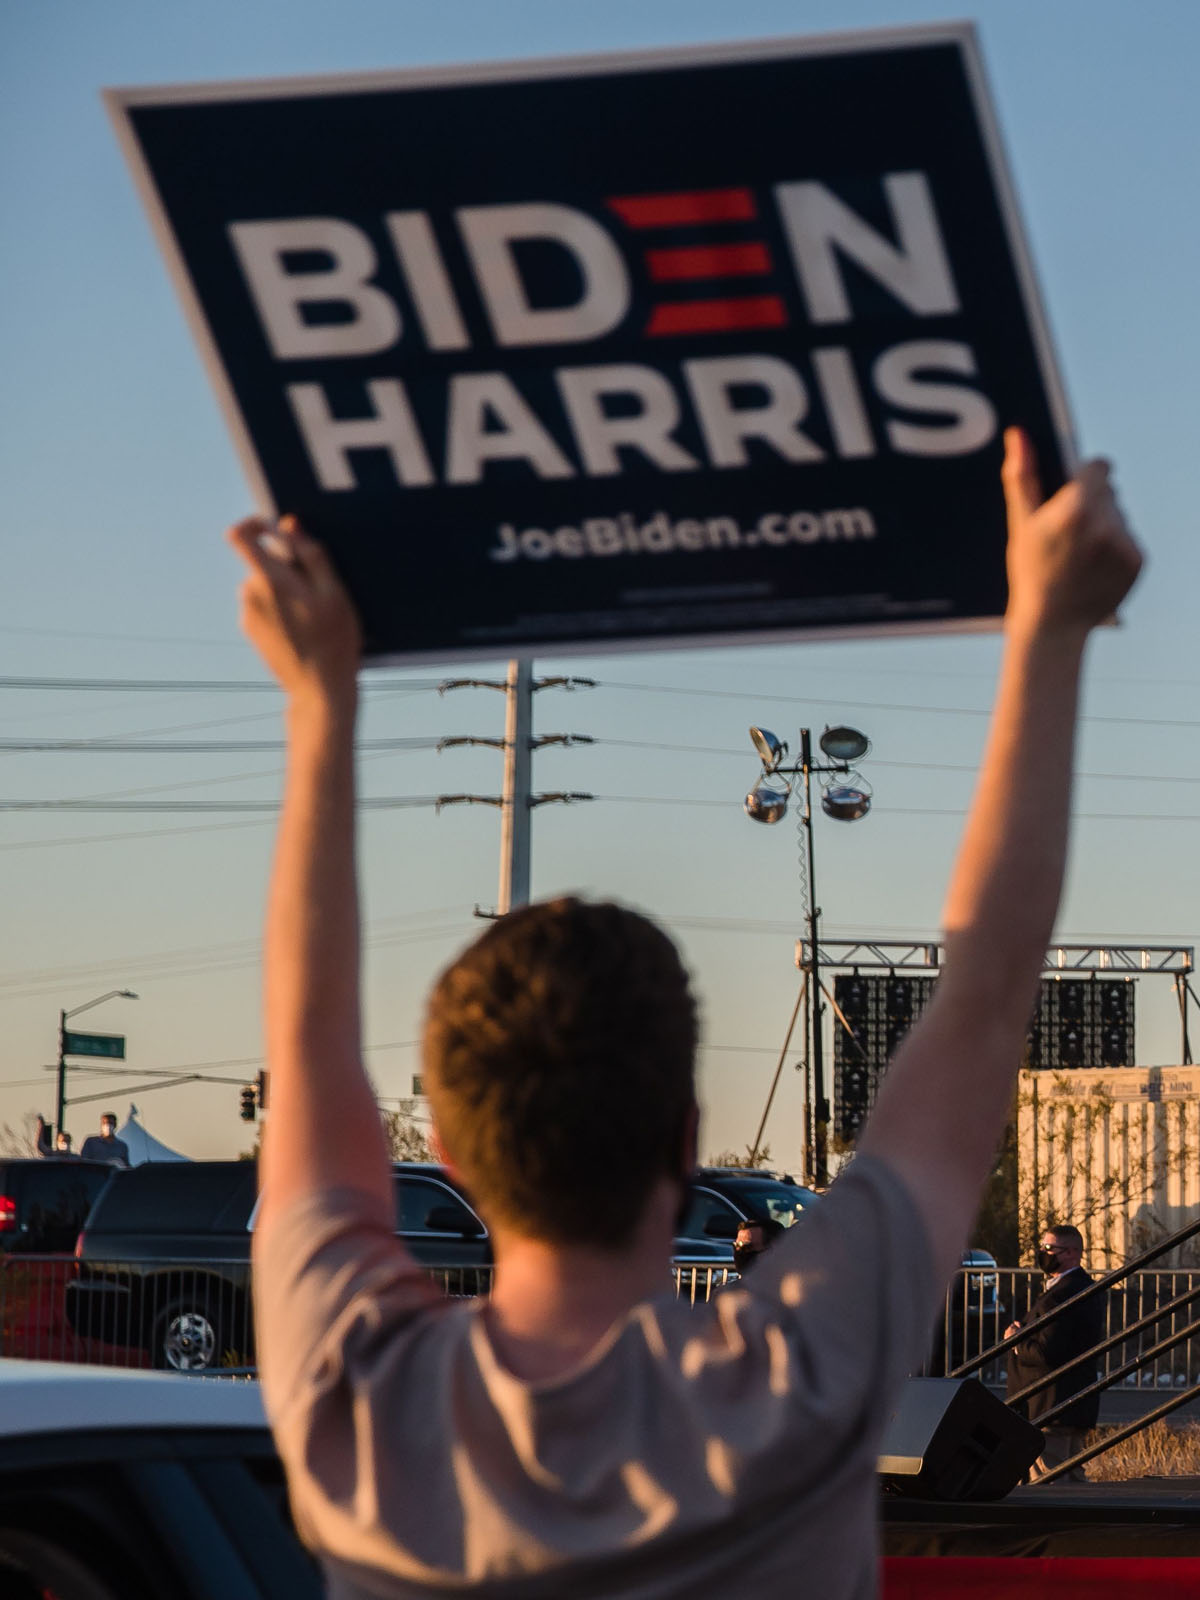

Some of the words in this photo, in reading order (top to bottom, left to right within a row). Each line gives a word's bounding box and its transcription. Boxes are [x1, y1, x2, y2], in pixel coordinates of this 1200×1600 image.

[228, 171, 961, 361] BIDEN
[286, 339, 997, 491] HARRIS
[490, 507, 876, 562] JoeBiden.com
